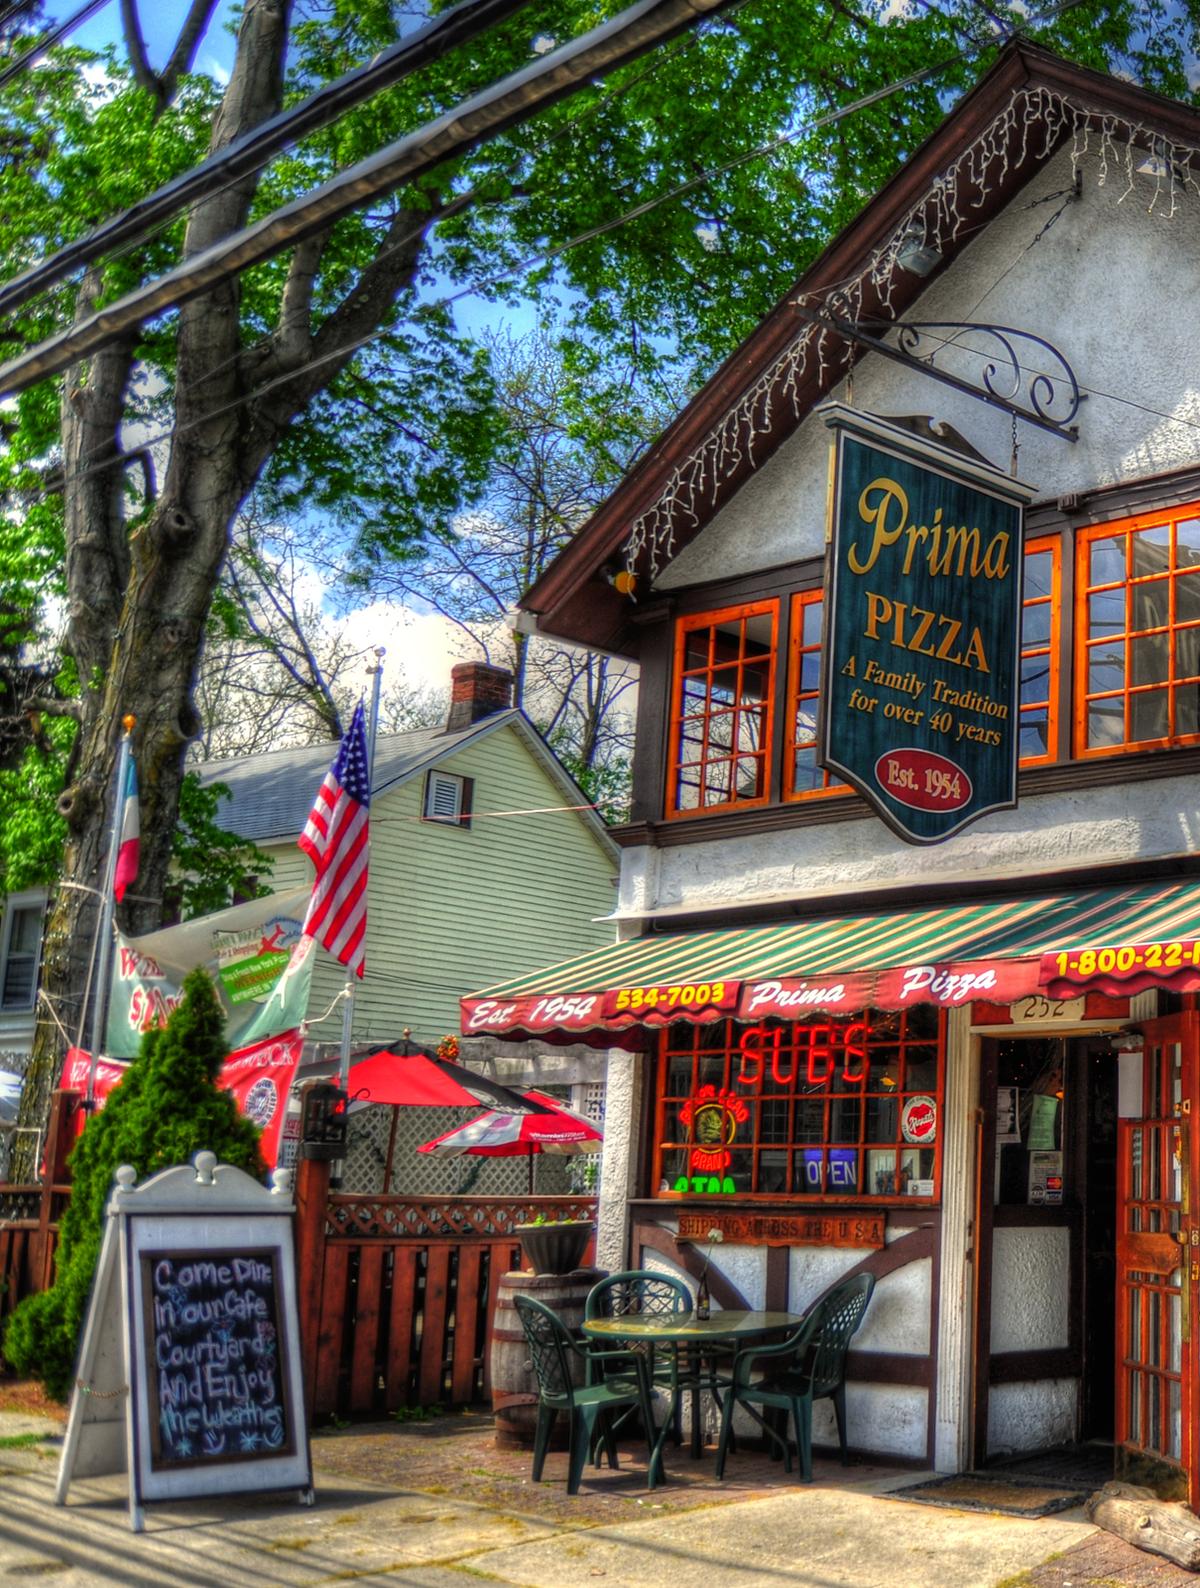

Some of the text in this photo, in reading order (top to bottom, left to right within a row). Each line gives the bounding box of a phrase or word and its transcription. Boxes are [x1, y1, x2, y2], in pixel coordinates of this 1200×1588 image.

[847, 477, 1010, 581] Prima
[864, 591, 991, 673] PIZZA
[841, 656, 1009, 719] A Family Tradition
[848, 689, 1002, 746] for over 40 years
[887, 759, 962, 800] Est. 1954
[616, 983, 725, 1010] 534-7003
[751, 980, 846, 1011] Prima
[900, 965, 998, 1003] Pizza
[469, 995, 597, 1026] Est. 1954
[1023, 997, 1066, 1018] 252
[806, 1161, 857, 1185] OPEN
[679, 1218, 741, 1235] SHIPPING
[748, 1221, 799, 1238] ACROSS
[805, 1222, 831, 1238] THE
[154, 1258, 273, 1291] Come Dine
[181, 1298, 226, 1324] our
[224, 1288, 268, 1318] Cafe
[155, 1329, 266, 1370] Courtyard
[159, 1363, 276, 1404] And Enjoy
[201, 1400, 284, 1431] Weather
